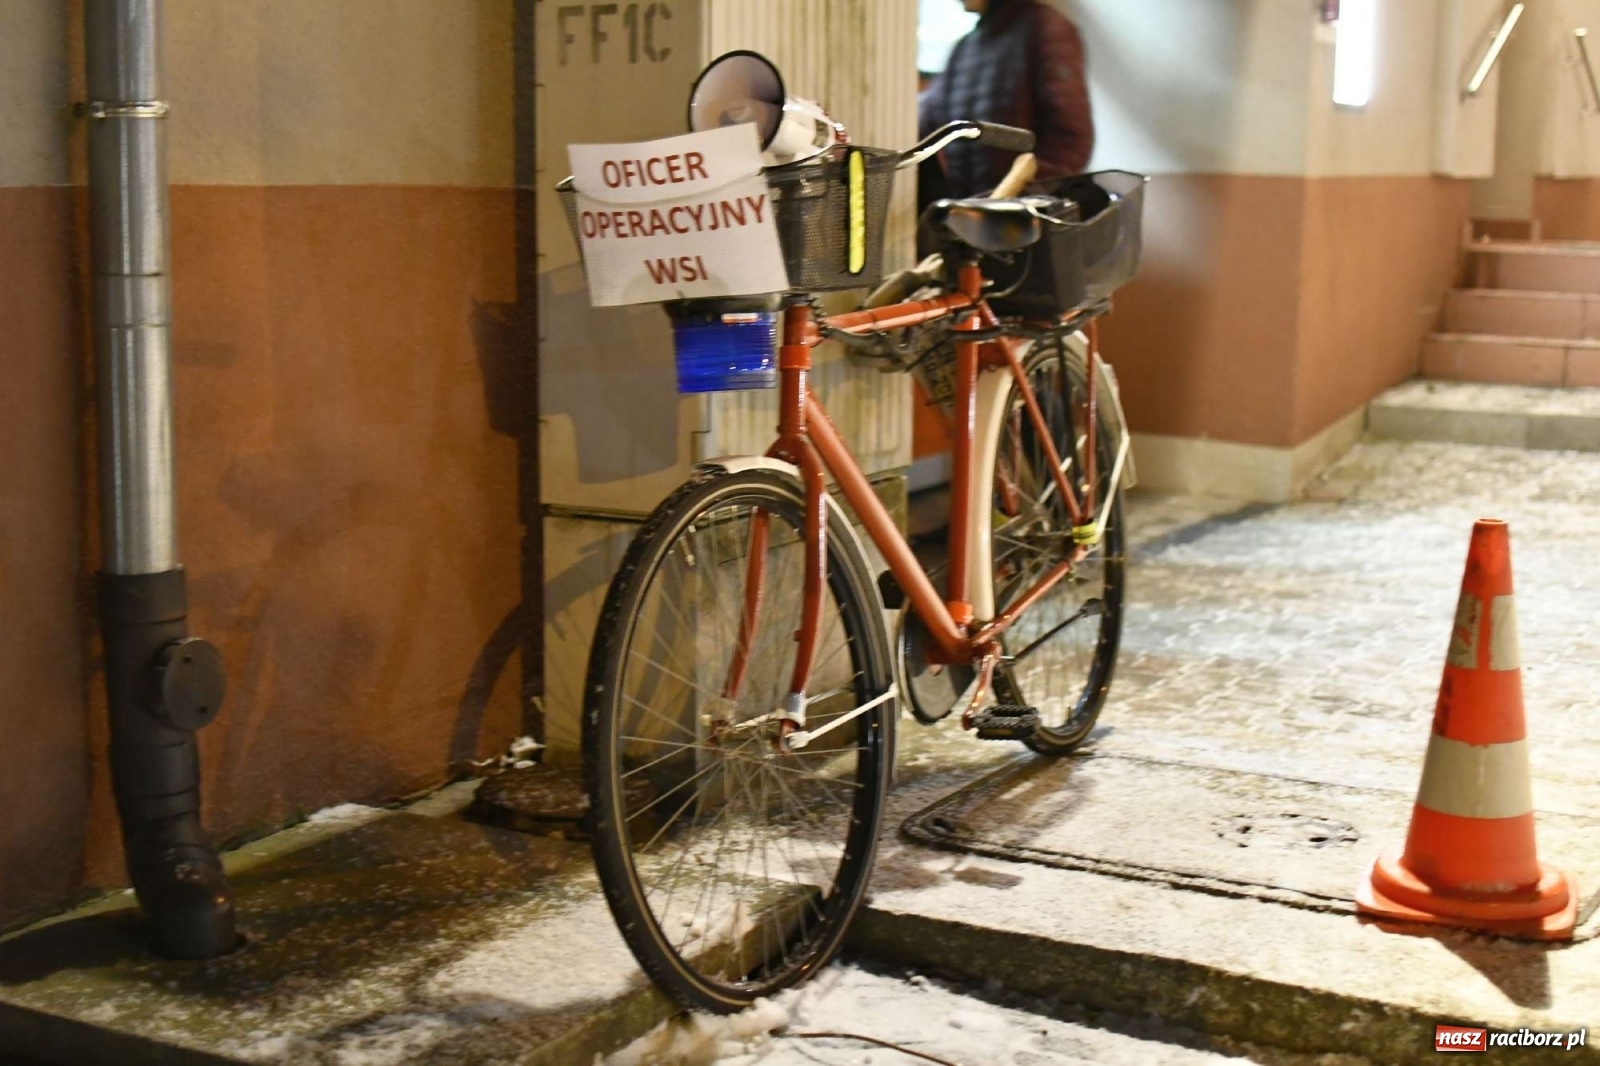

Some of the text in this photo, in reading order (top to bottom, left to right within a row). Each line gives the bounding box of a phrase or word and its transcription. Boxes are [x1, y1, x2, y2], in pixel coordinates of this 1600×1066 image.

[603, 151, 709, 188] OFICER
[580, 194, 766, 239] OPERACYJNY
[644, 255, 709, 285] WSI
